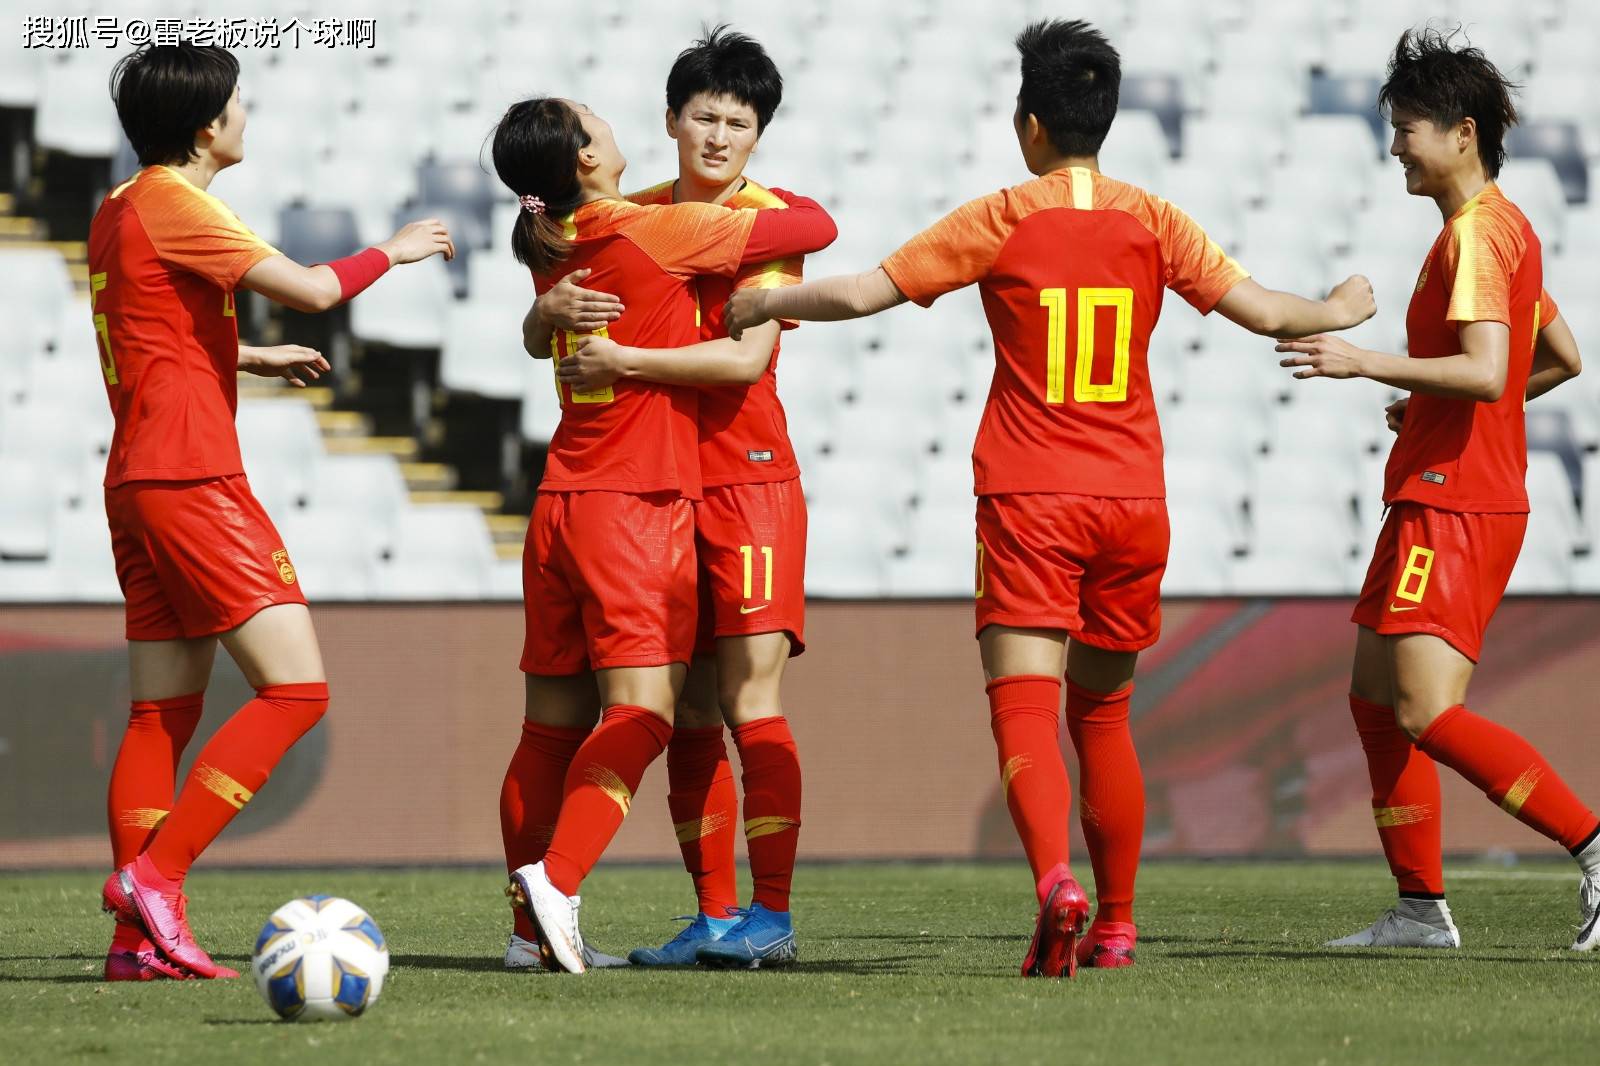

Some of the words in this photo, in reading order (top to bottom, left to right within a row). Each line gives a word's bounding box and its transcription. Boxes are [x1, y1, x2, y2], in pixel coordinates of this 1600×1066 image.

[1040, 287, 1133, 403] 10
[740, 545, 773, 600] 11
[1396, 544, 1435, 603] 8
